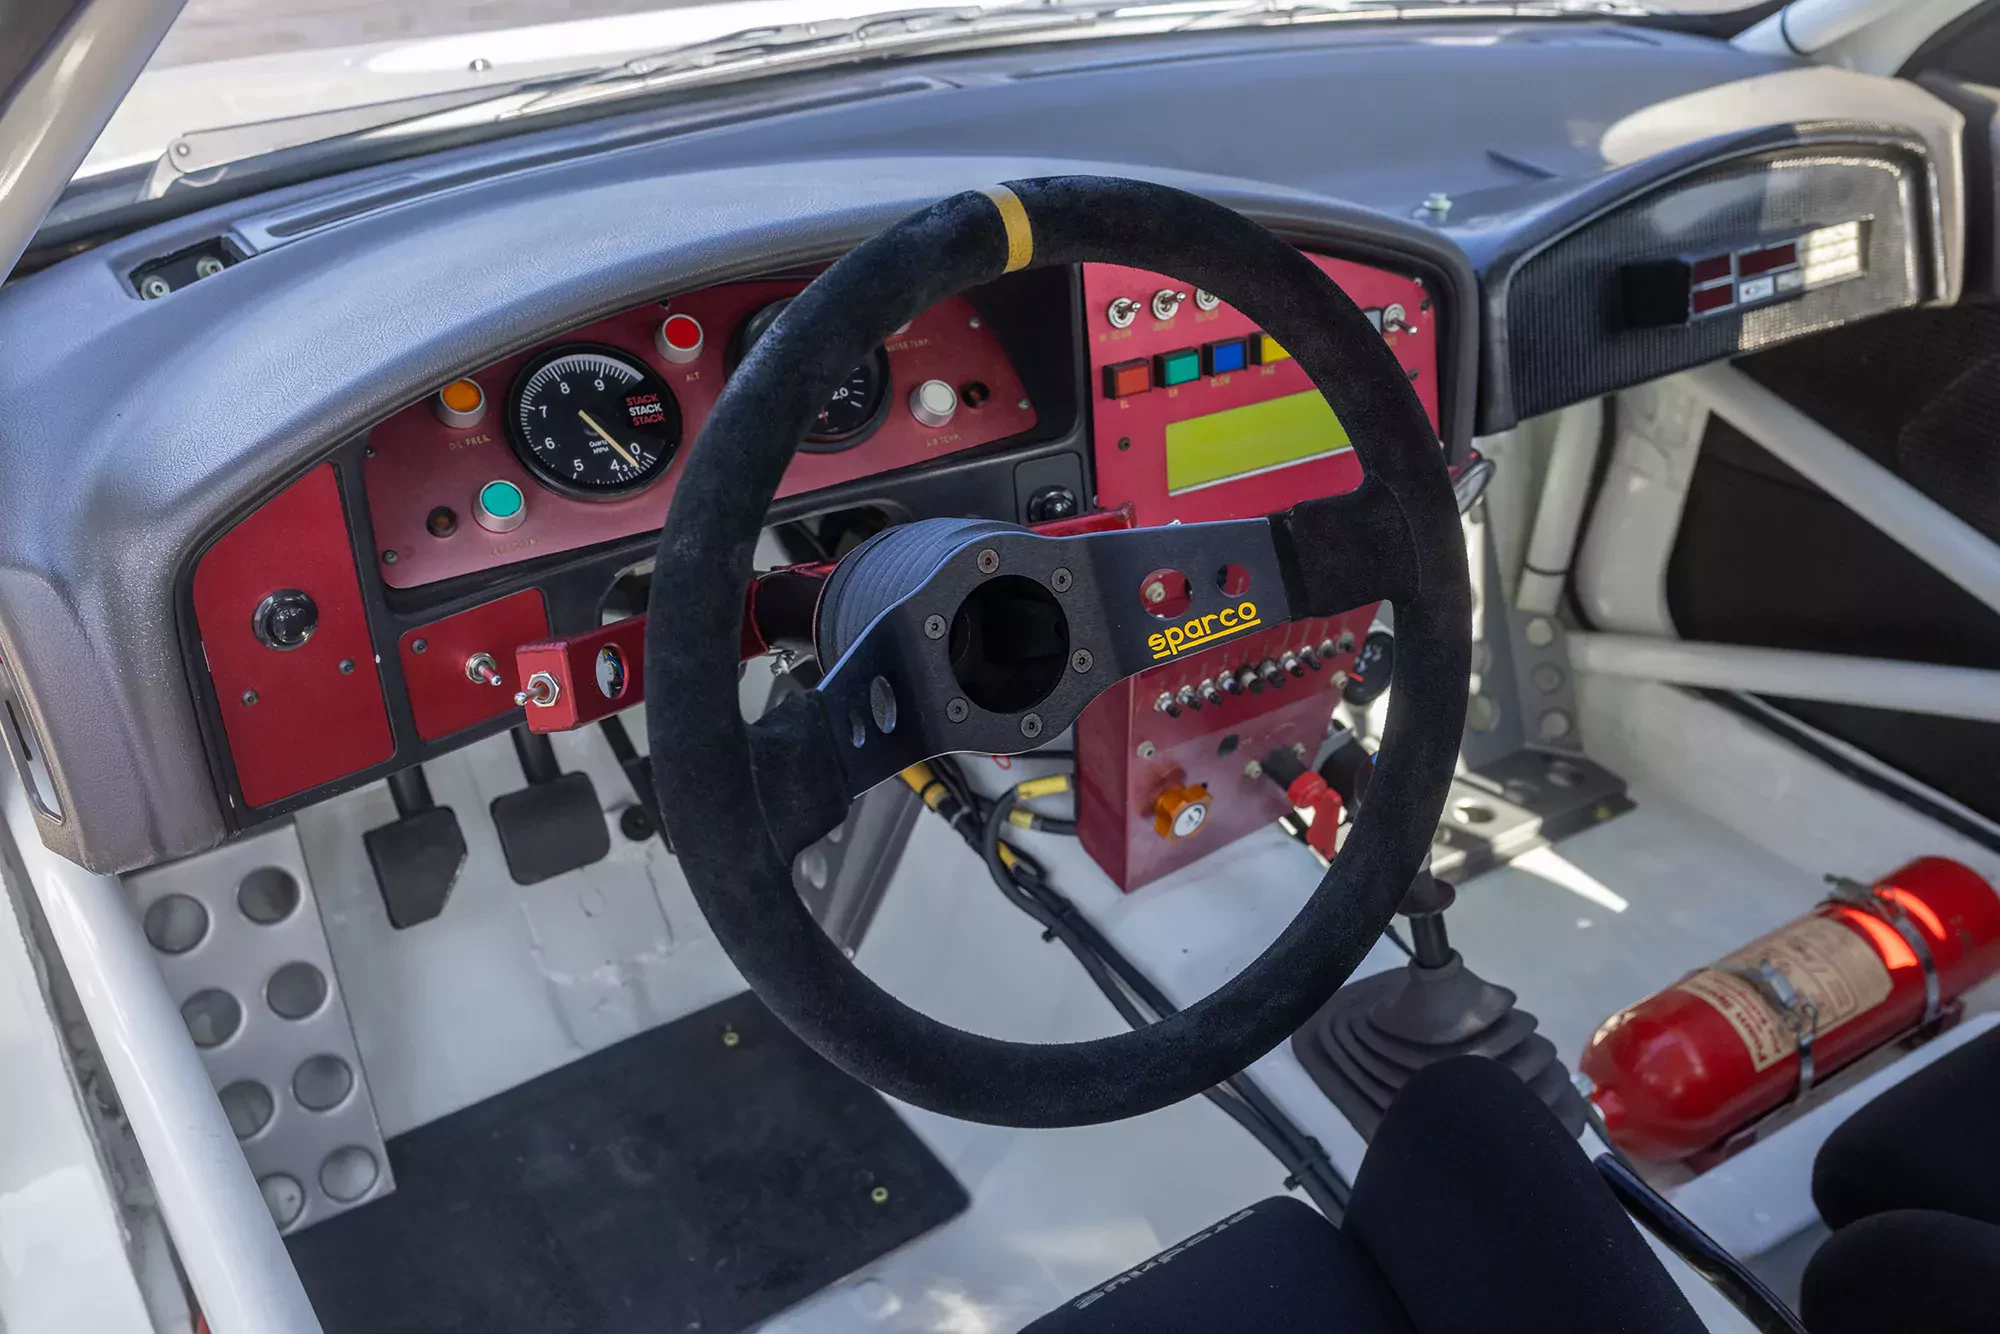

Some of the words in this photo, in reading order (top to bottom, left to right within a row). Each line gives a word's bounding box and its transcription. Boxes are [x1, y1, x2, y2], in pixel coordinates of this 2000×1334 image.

[686, 371, 700, 382] ALT
[560, 382, 570, 394] 8
[594, 379, 605, 391] 9
[625, 393, 659, 407] STACK
[539, 405, 548, 418] 7
[629, 403, 663, 416] STACK
[632, 413, 665, 426] STACK
[544, 437, 555, 450] 6
[630, 442, 641, 455] 0
[573, 459, 584, 471] 5
[610, 459, 620, 471] 4
[622, 464, 628, 472] 3
[1148, 602, 1258, 656] sparco
